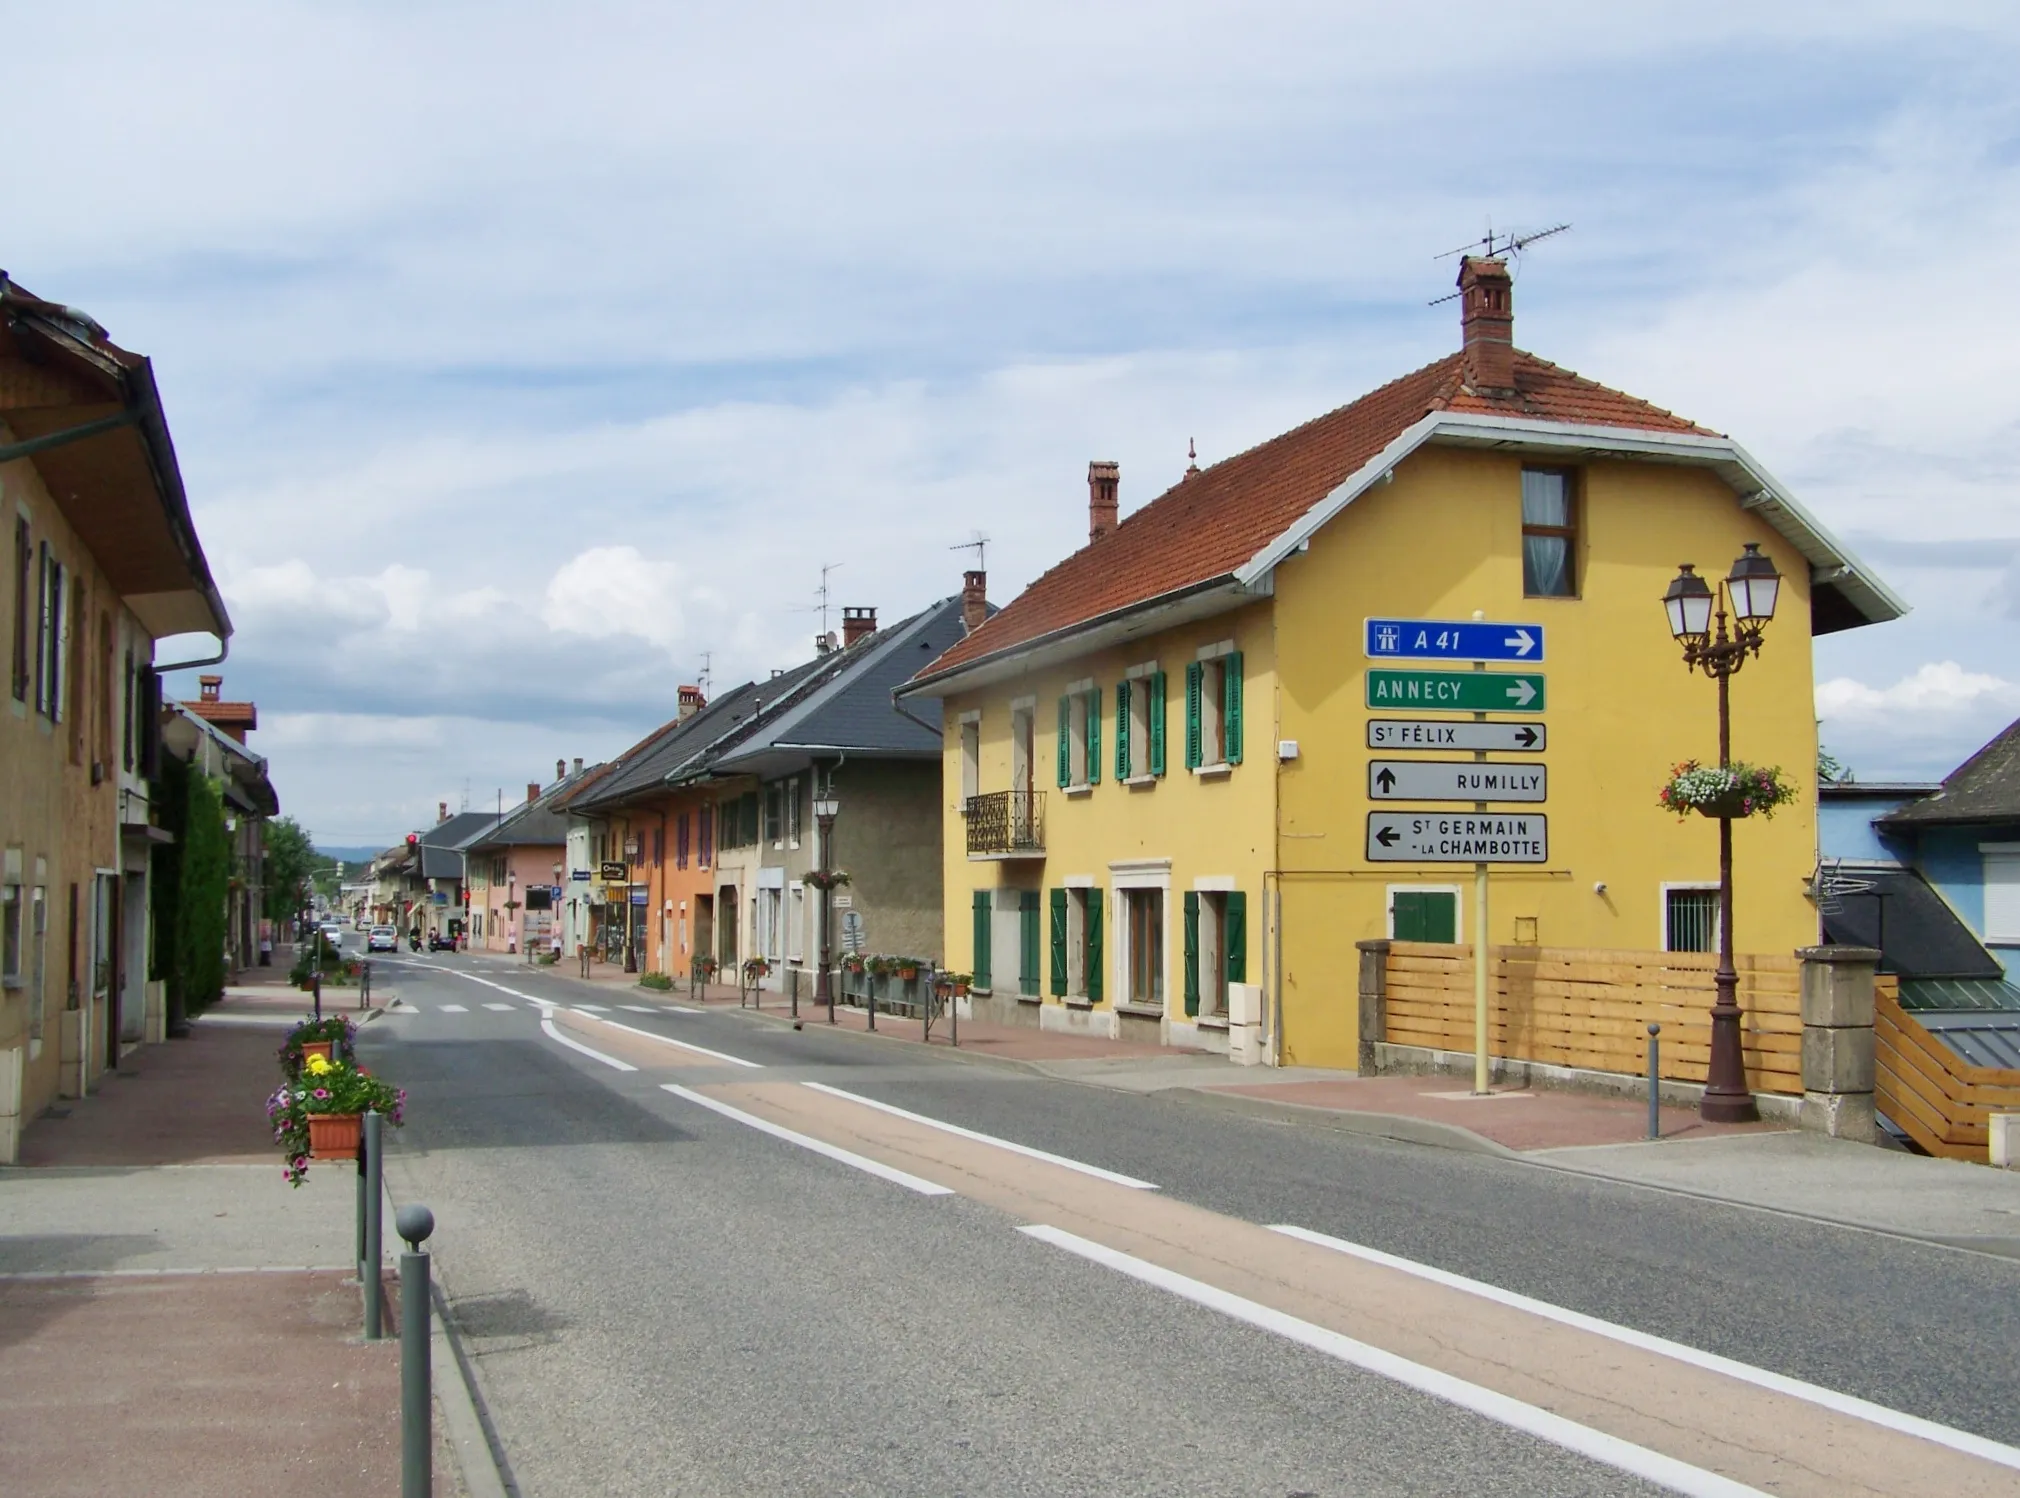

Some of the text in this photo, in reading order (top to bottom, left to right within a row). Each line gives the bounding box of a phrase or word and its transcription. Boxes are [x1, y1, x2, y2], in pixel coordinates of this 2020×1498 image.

[1414, 630, 1460, 650] A 41
[1376, 680, 1462, 700] ANNECY
[1402, 725, 1456, 743] FÉLIX
[1458, 774, 1539, 790] RUMILLY
[1440, 820, 1527, 835] GERMAIN
[1440, 840, 1540, 855] CHAMBOTTE
